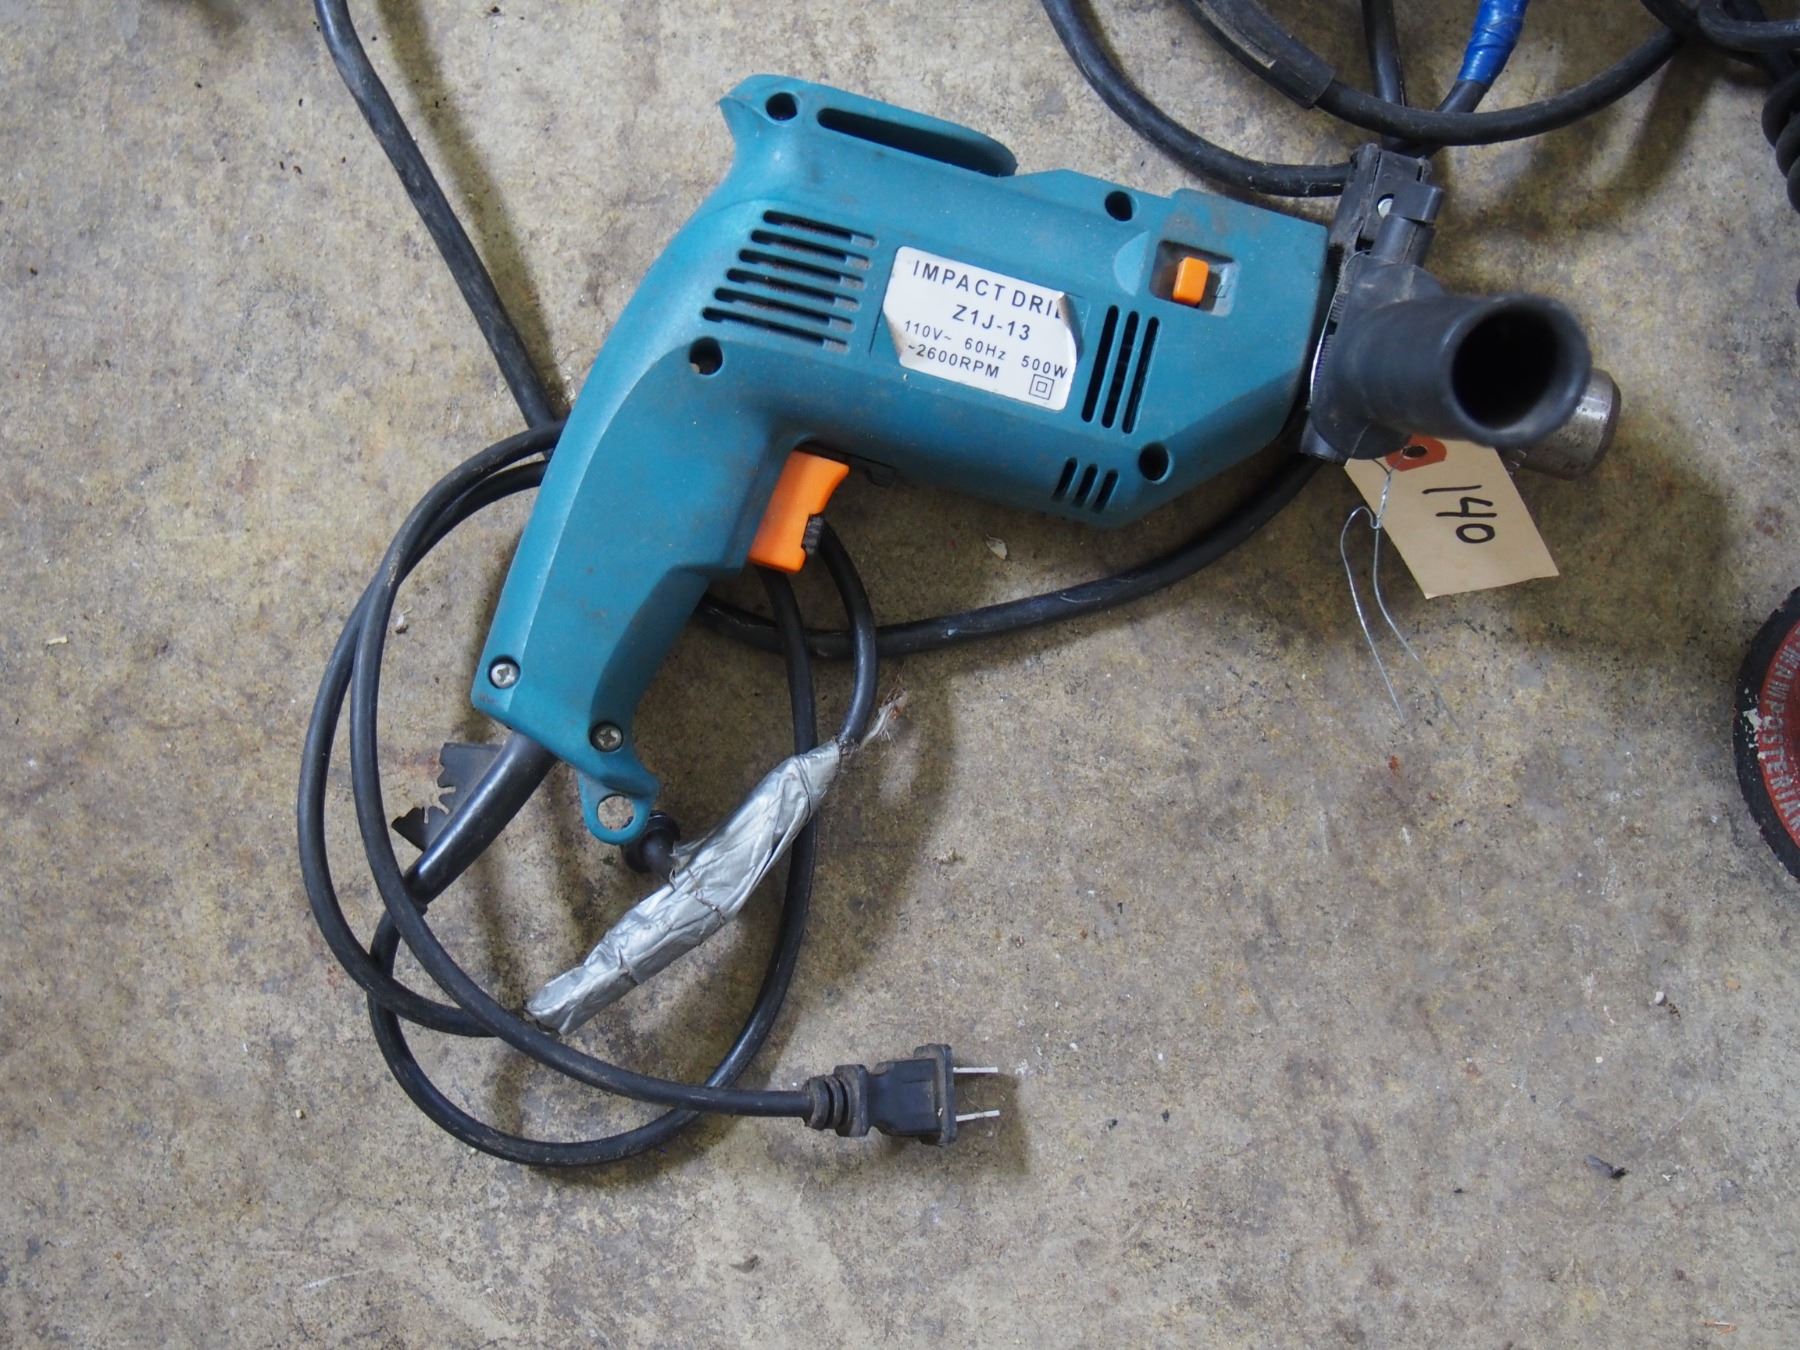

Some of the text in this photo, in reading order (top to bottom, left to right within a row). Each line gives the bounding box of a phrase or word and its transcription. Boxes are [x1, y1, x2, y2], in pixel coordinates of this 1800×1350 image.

[913, 260, 1006, 302] IMPACT
[952, 304, 1031, 341] Z1J-13
[905, 320, 1068, 379] 110V~ 60Hz 500W
[1421, 484, 1498, 544] 140
